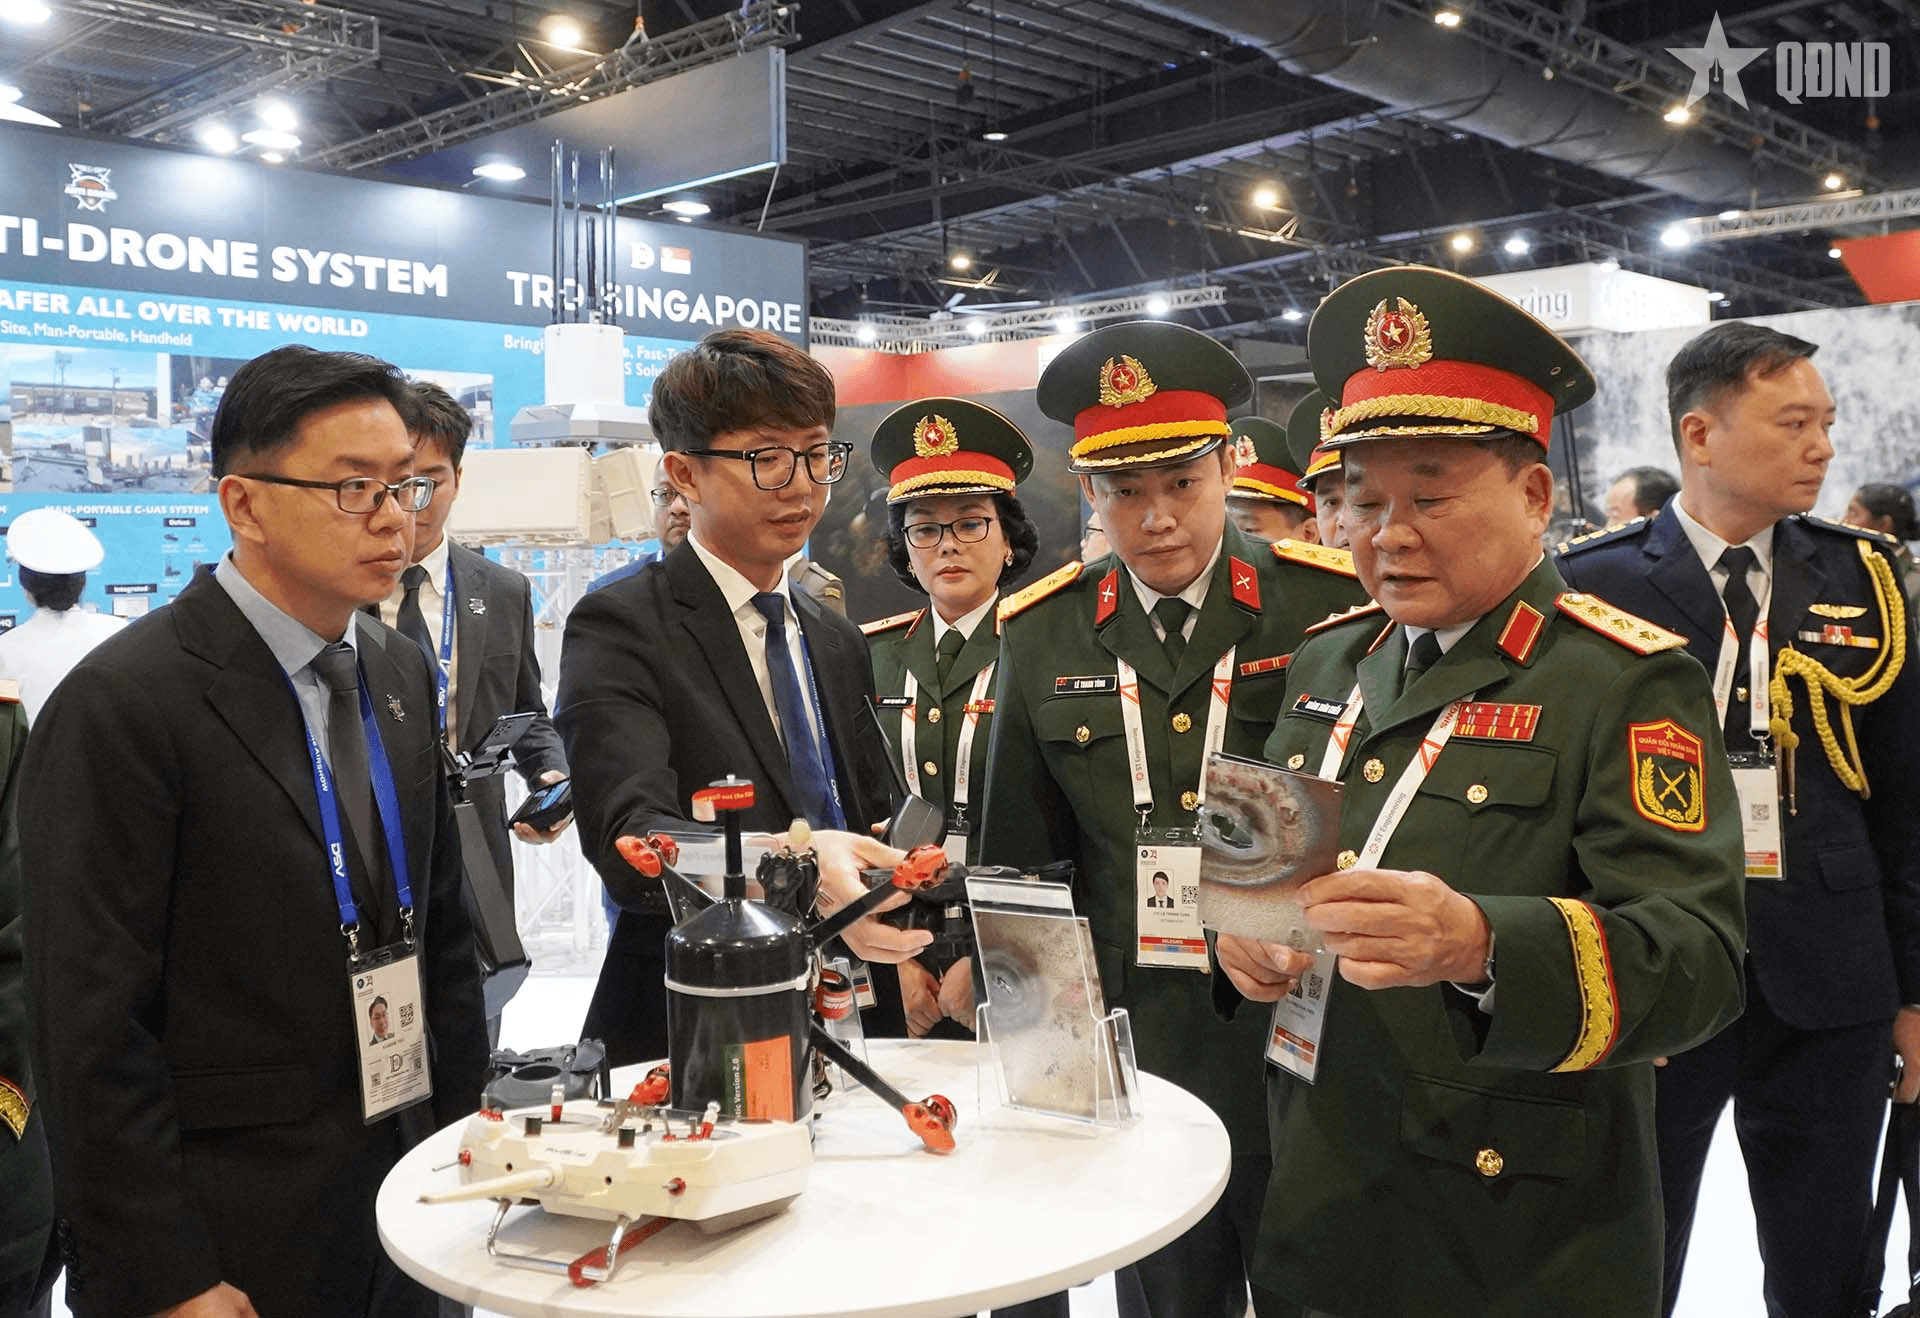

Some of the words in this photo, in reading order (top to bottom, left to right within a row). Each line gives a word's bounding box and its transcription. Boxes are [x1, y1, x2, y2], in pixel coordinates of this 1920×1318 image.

[271, 246, 447, 298] SYSTEM
[0, 288, 70, 316] AFER
[76, 296, 132, 321] ALL
[138, 301, 212, 327] OVER
[217, 307, 271, 331] THE
[279, 313, 368, 338] WORLD
[506, 271, 584, 312] TRD
[600, 281, 801, 333] SINGAPORE
[1, 319, 31, 336] Site,
[33, 322, 129, 344] Man-Portable,
[131, 331, 193, 347] Handheld
[134, 505, 167, 515] C-UAS
[169, 506, 210, 515] SYSTEM
[437, 687, 446, 707] DSV
[315, 747, 328, 792] AIRSHOW
[1374, 832, 1384, 843] ST
[1381, 792, 1407, 834] Engineering
[330, 842, 346, 878] DSV
[731, 1057, 740, 1072] 2.0
[733, 1072, 741, 1104] Version
